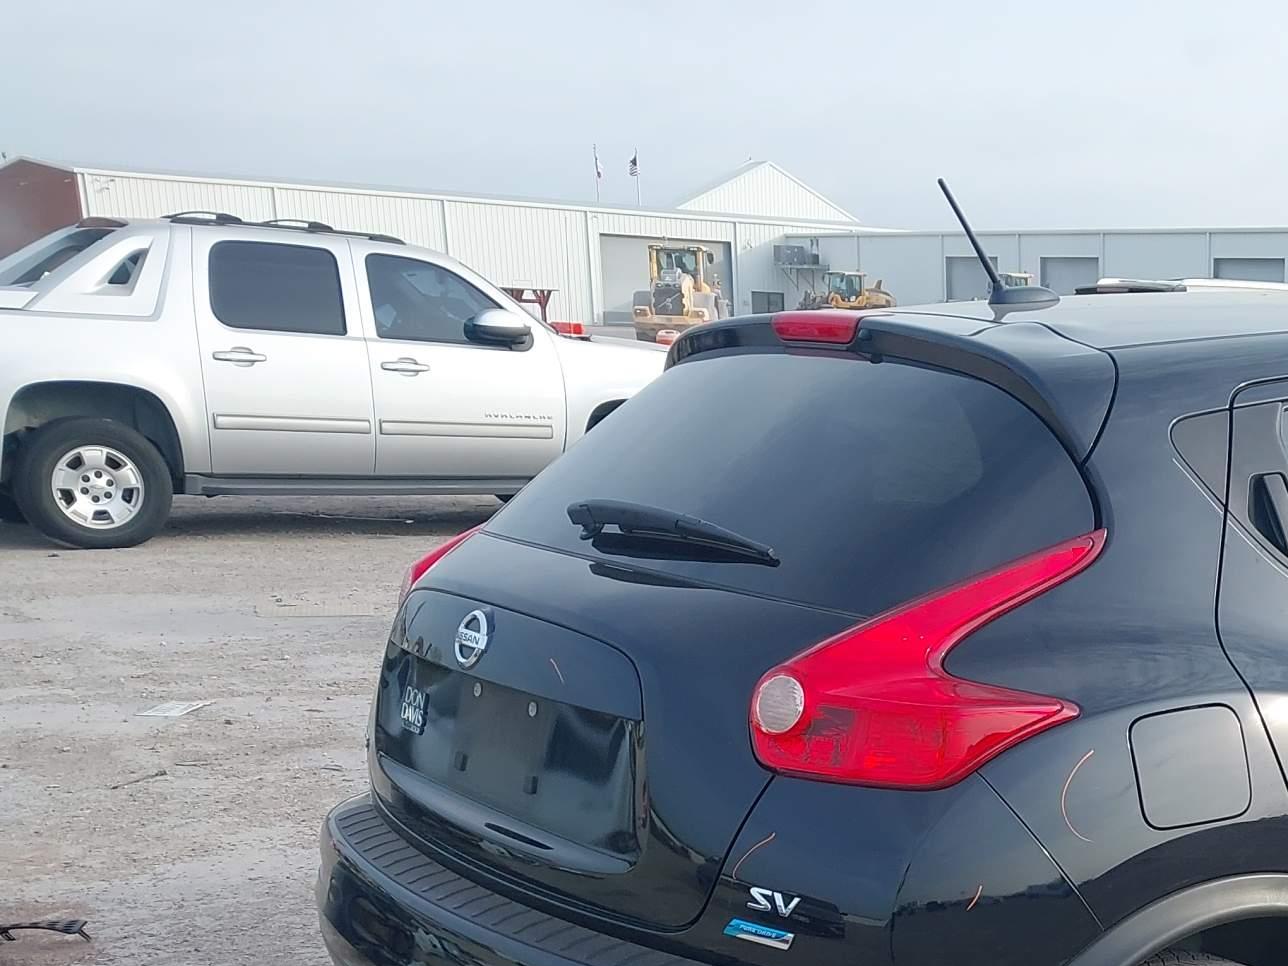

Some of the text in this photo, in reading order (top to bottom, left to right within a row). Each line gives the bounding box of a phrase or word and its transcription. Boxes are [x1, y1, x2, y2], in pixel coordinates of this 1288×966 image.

[405, 685, 426, 710] DON
[400, 702, 424, 727] DAVIS
[746, 886, 801, 918] SV
